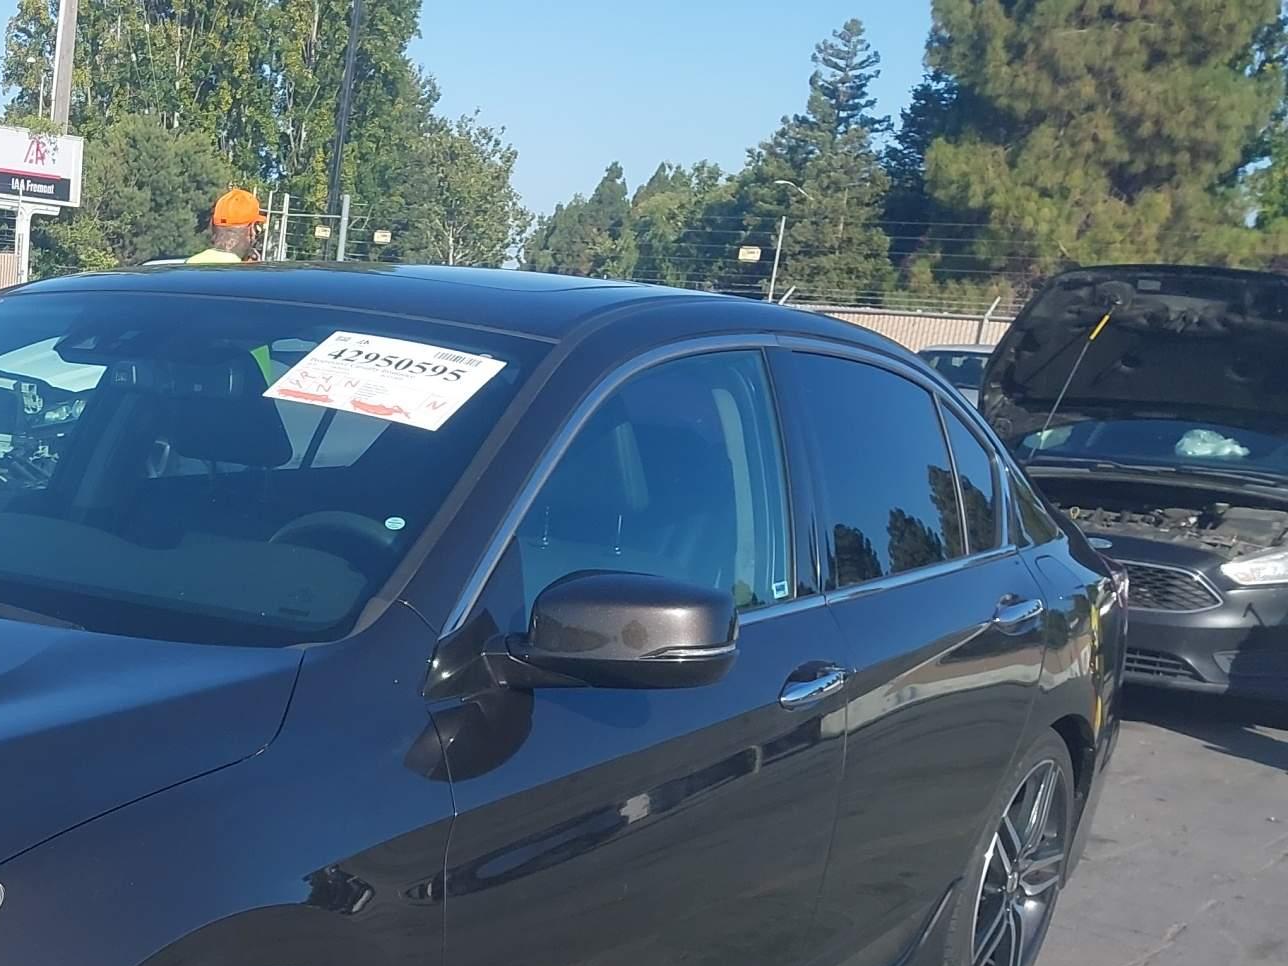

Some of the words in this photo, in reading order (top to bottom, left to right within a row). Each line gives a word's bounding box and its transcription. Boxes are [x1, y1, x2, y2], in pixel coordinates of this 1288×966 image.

[11, 177, 26, 191] IAA
[26, 179, 55, 195] Fremont
[327, 347, 467, 383] 42950595
